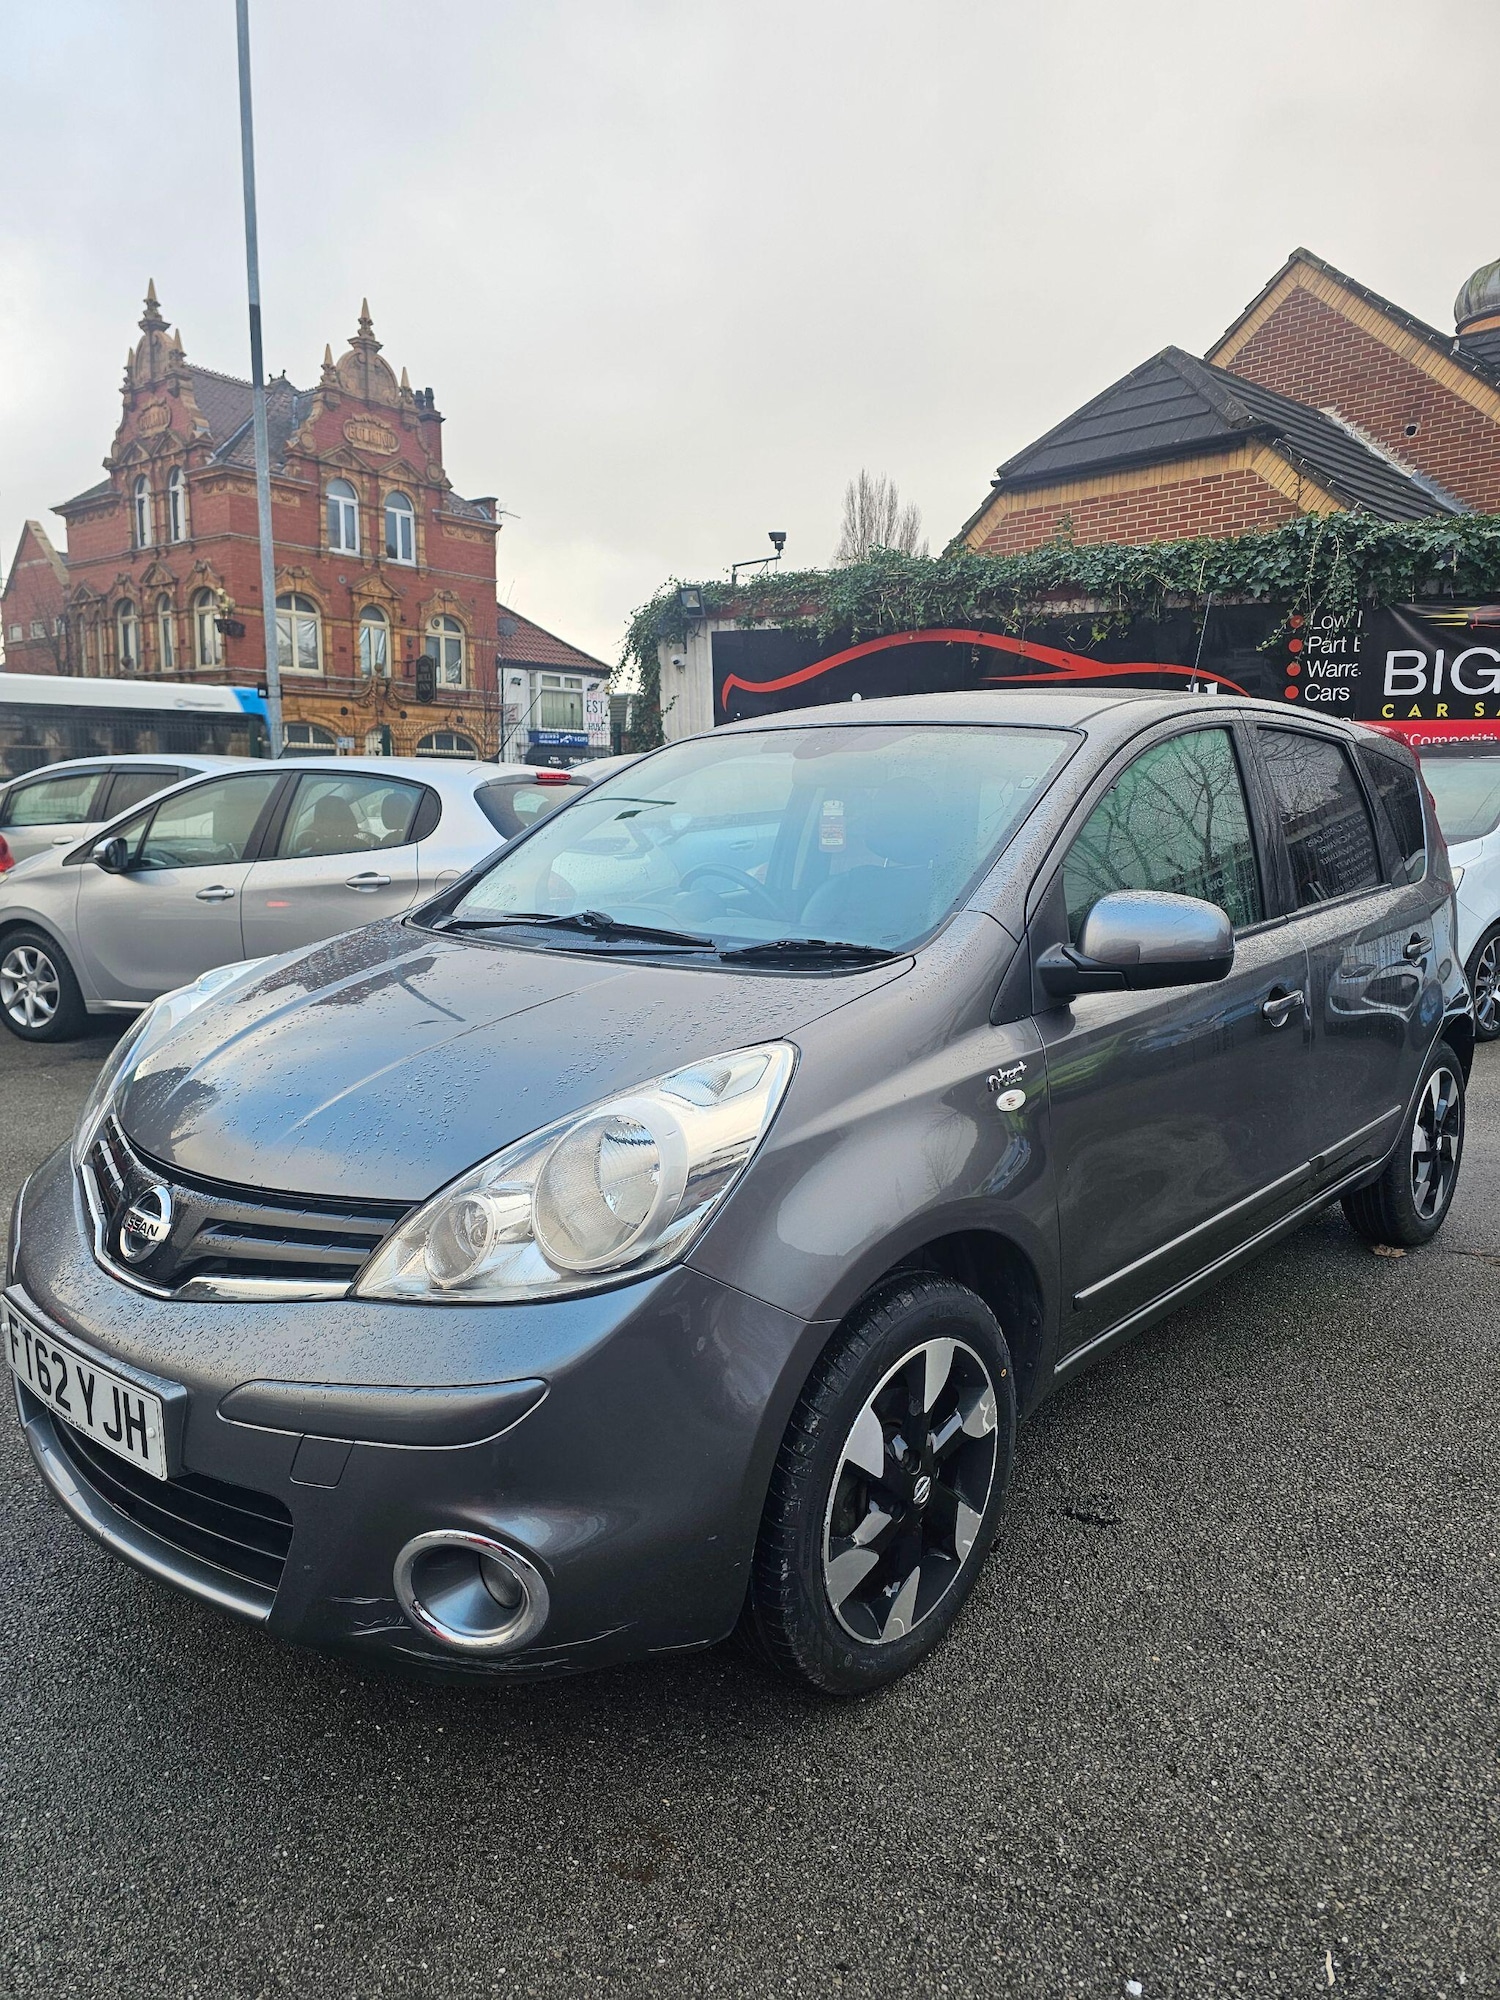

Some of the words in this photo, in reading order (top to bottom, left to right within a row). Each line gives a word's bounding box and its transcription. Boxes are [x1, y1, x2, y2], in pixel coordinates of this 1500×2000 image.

[1308, 636, 1347, 654] Part
[1383, 646, 1500, 696] BIG
[1304, 683, 1350, 702] Cars
[1381, 703, 1449, 718] CAR
[8, 1311, 72, 1413] FT62
[76, 1365, 149, 1460] YJH
